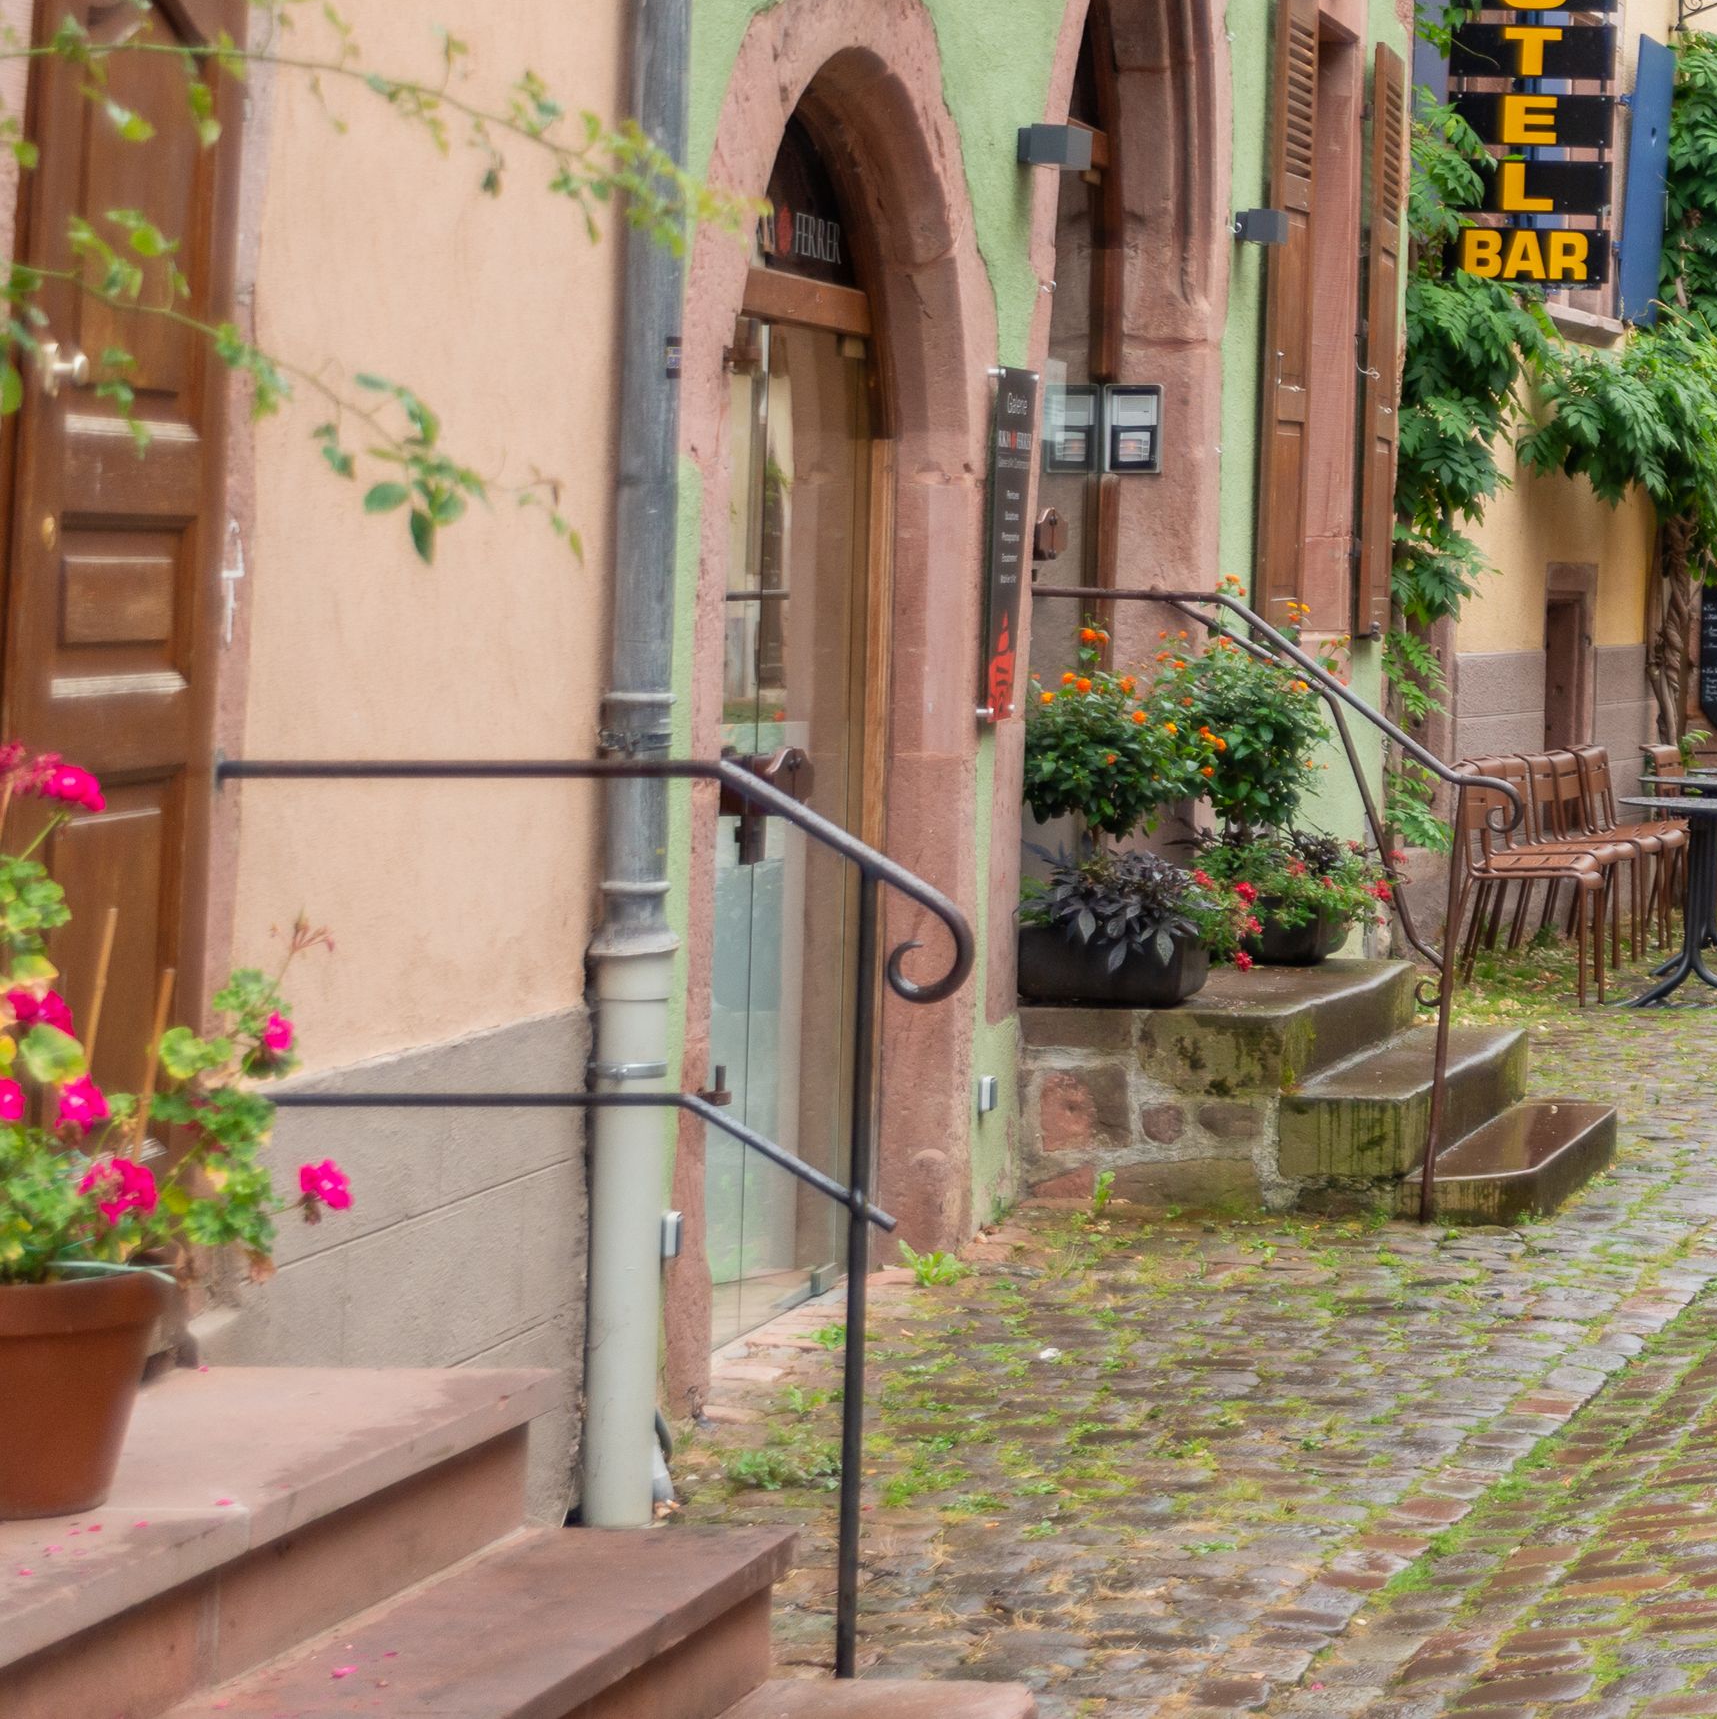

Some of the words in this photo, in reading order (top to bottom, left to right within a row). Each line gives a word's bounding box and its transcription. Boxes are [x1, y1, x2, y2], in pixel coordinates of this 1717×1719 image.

[795, 212, 842, 265] FERRER
[1464, 230, 1588, 281] BAR
[1007, 392, 1028, 416] Galerie
